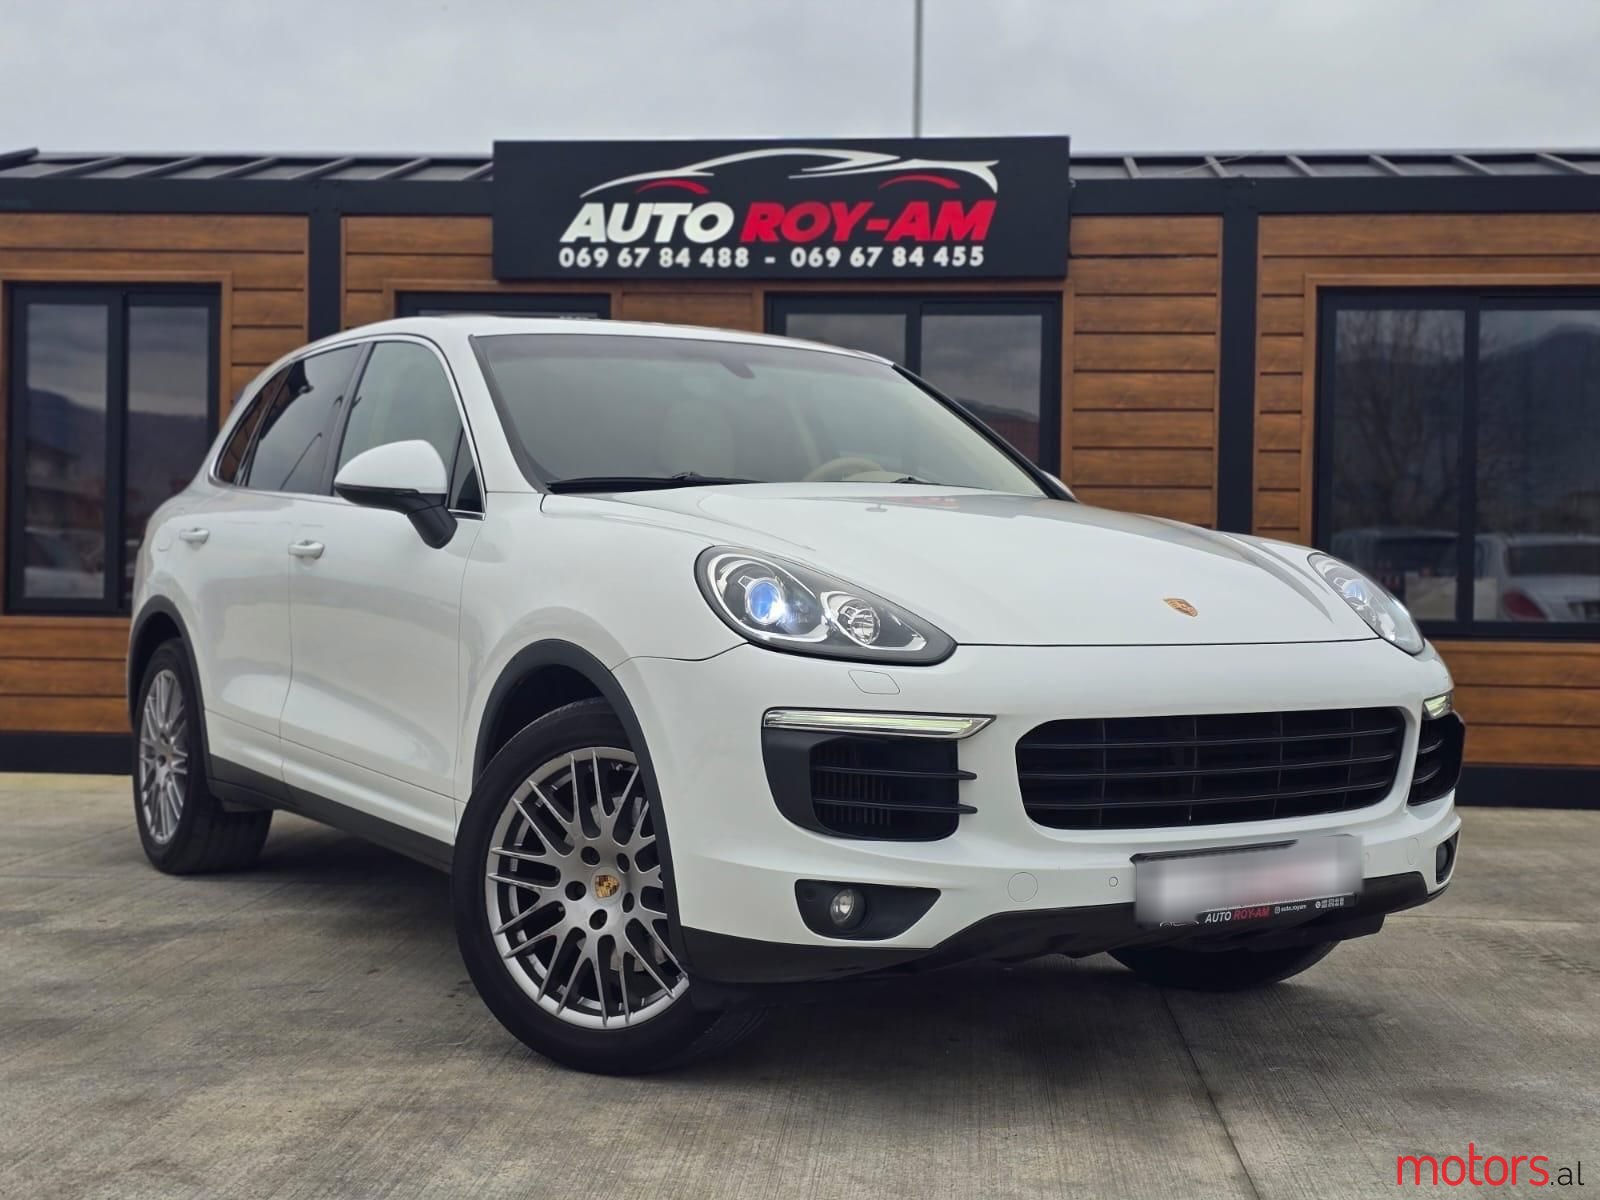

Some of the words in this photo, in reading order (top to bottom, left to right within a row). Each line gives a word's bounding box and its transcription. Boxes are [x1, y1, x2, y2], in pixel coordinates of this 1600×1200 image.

[560, 202, 735, 243] AUTO
[740, 200, 997, 243] ROY-AM
[559, 247, 609, 268] 069
[616, 247, 650, 268] 67
[658, 247, 691, 268] 84
[699, 247, 750, 268] 488
[790, 247, 841, 268] 069
[849, 247, 883, 268] 67
[892, 247, 924, 267] 84
[933, 247, 985, 267] 455
[1204, 911, 1232, 924] AUTO
